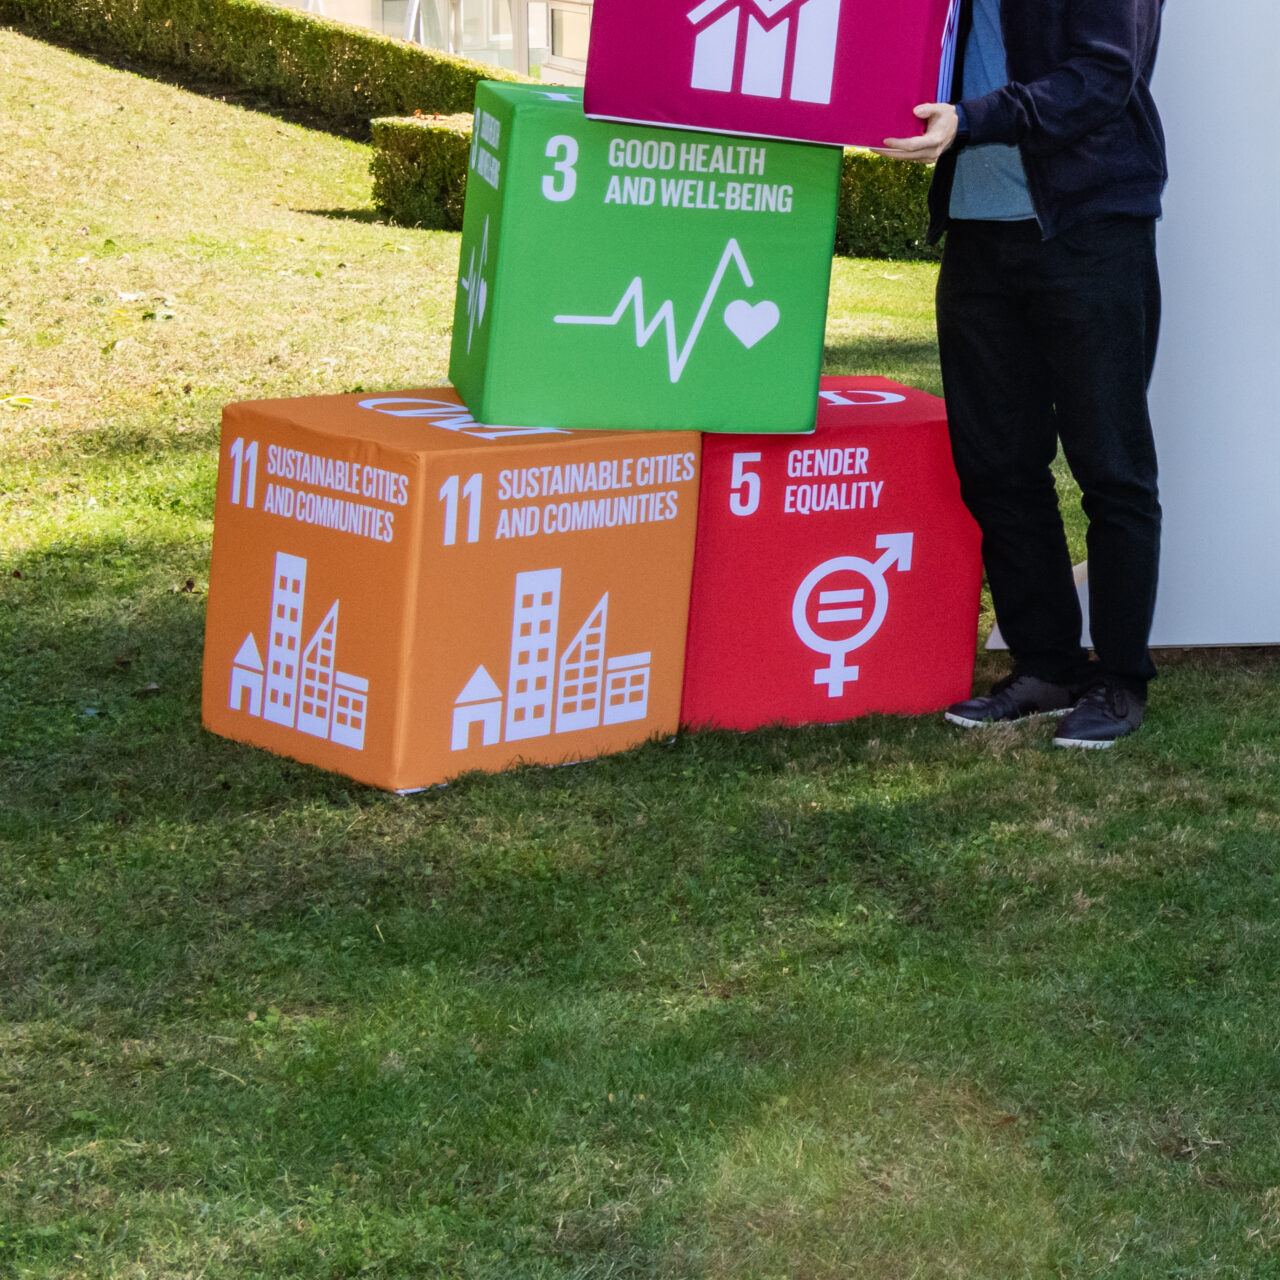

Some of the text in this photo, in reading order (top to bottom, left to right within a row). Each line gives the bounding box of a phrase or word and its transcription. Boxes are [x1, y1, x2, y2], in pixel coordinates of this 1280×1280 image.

[541, 135, 578, 202] 3
[608, 139, 765, 175] GOOD HEALTH
[604, 176, 792, 212] AND WELL-BEING
[230, 438, 258, 508] 11
[267, 445, 408, 506] SUSTAINABLE CITIES
[498, 452, 695, 500] SUSTAINABLE CITIES
[730, 452, 761, 516] 5
[788, 448, 869, 477] GENDER
[263, 483, 394, 542] AND COMMUNITIES
[439, 474, 482, 545] 11
[495, 491, 678, 539] AND COMMUNITIES
[784, 481, 884, 514] EQUALITY
